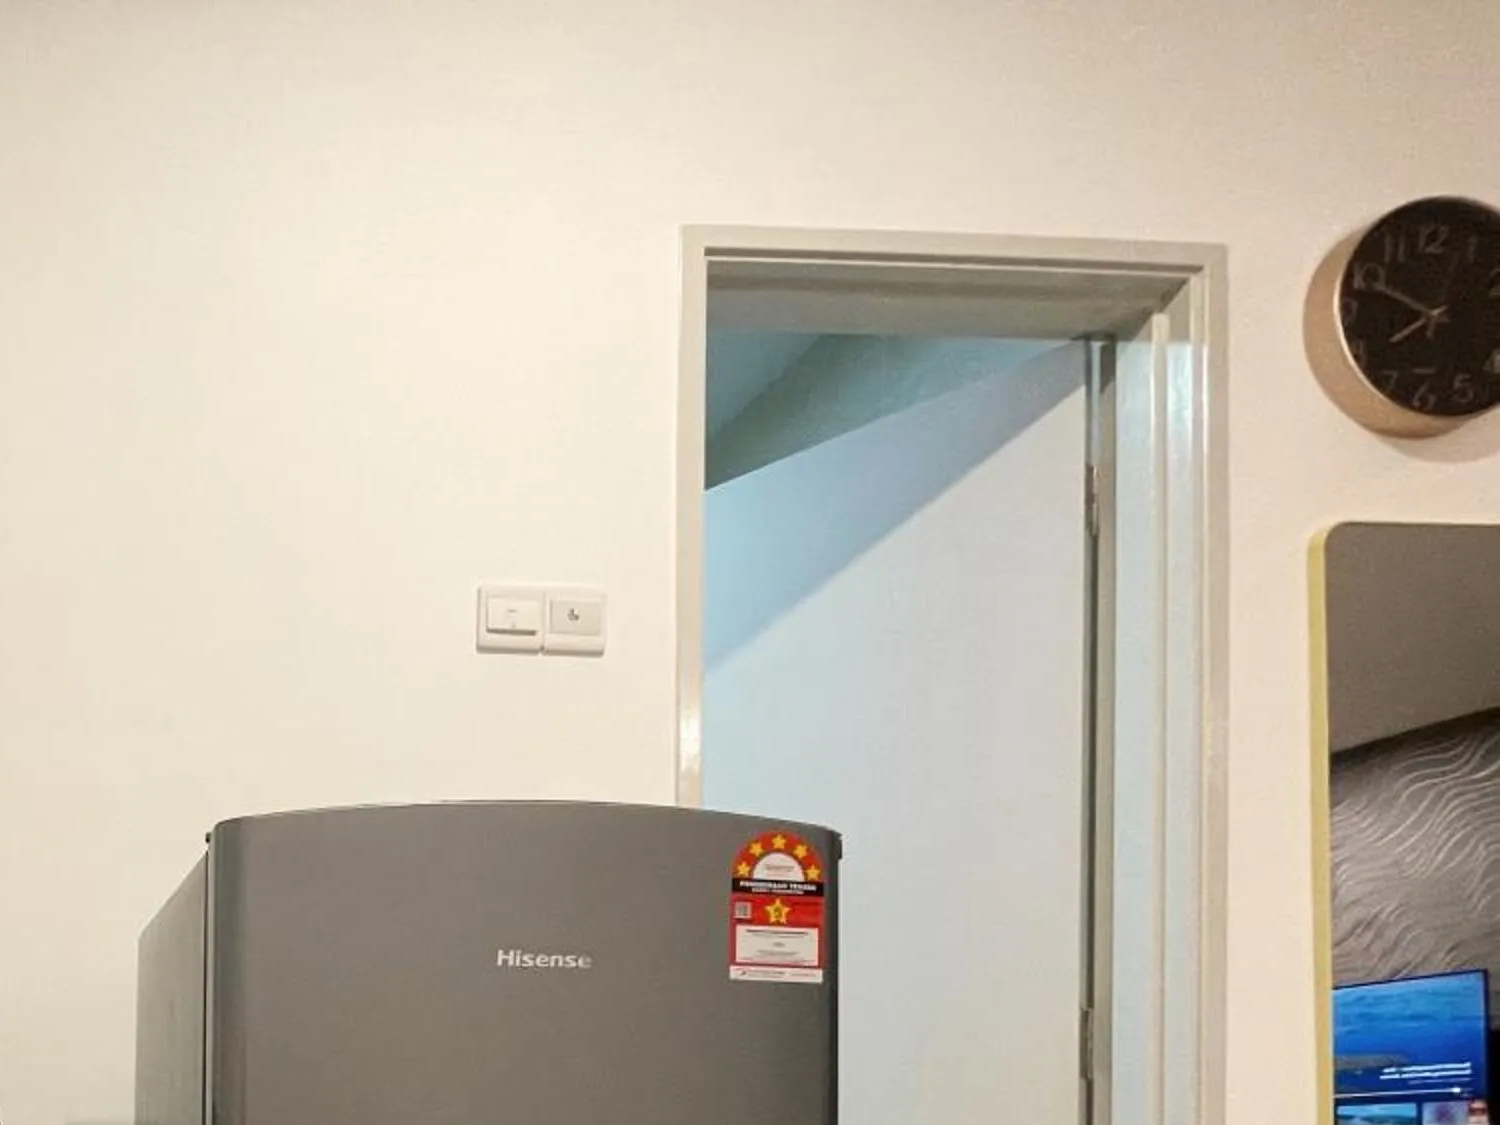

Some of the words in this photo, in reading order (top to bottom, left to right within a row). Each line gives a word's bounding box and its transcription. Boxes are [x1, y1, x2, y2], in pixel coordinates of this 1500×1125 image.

[1383, 232, 1406, 263] 11
[1418, 225, 1450, 255] 12
[1352, 261, 1388, 291] 10
[1381, 369, 1399, 394] 7
[496, 948, 593, 969] Hisense
